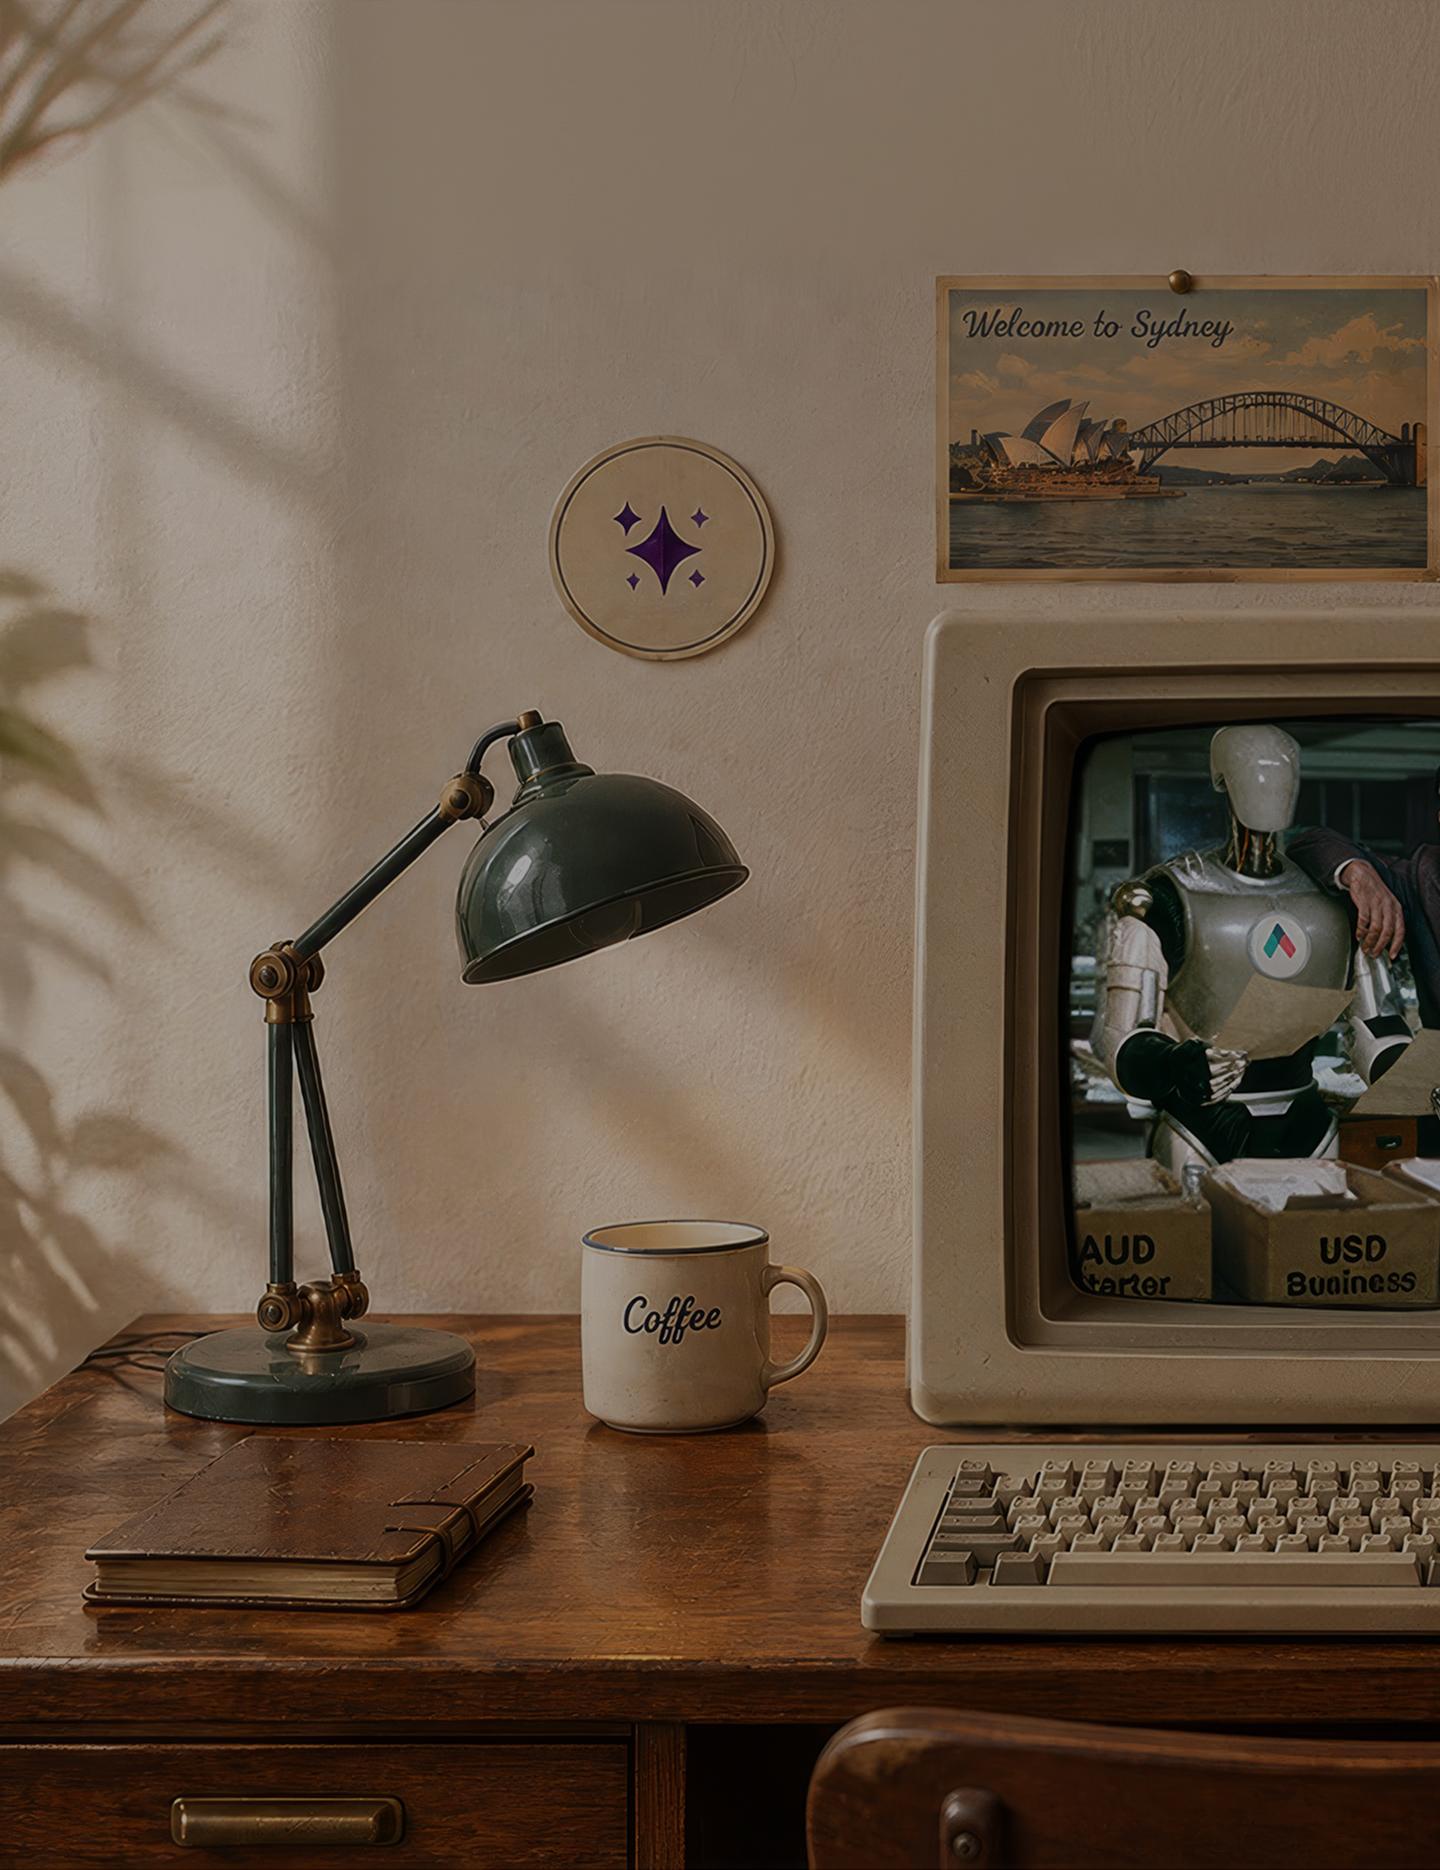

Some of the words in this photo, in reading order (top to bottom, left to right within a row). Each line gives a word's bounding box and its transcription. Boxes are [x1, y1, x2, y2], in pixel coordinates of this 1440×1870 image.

[963, 308, 1085, 338] Welcome
[1093, 310, 1122, 338] to
[1131, 308, 1234, 349] Sydney
[1080, 1235, 1155, 1265] AUD
[1320, 1235, 1387, 1264] USD
[624, 1295, 722, 1345] Coffee
